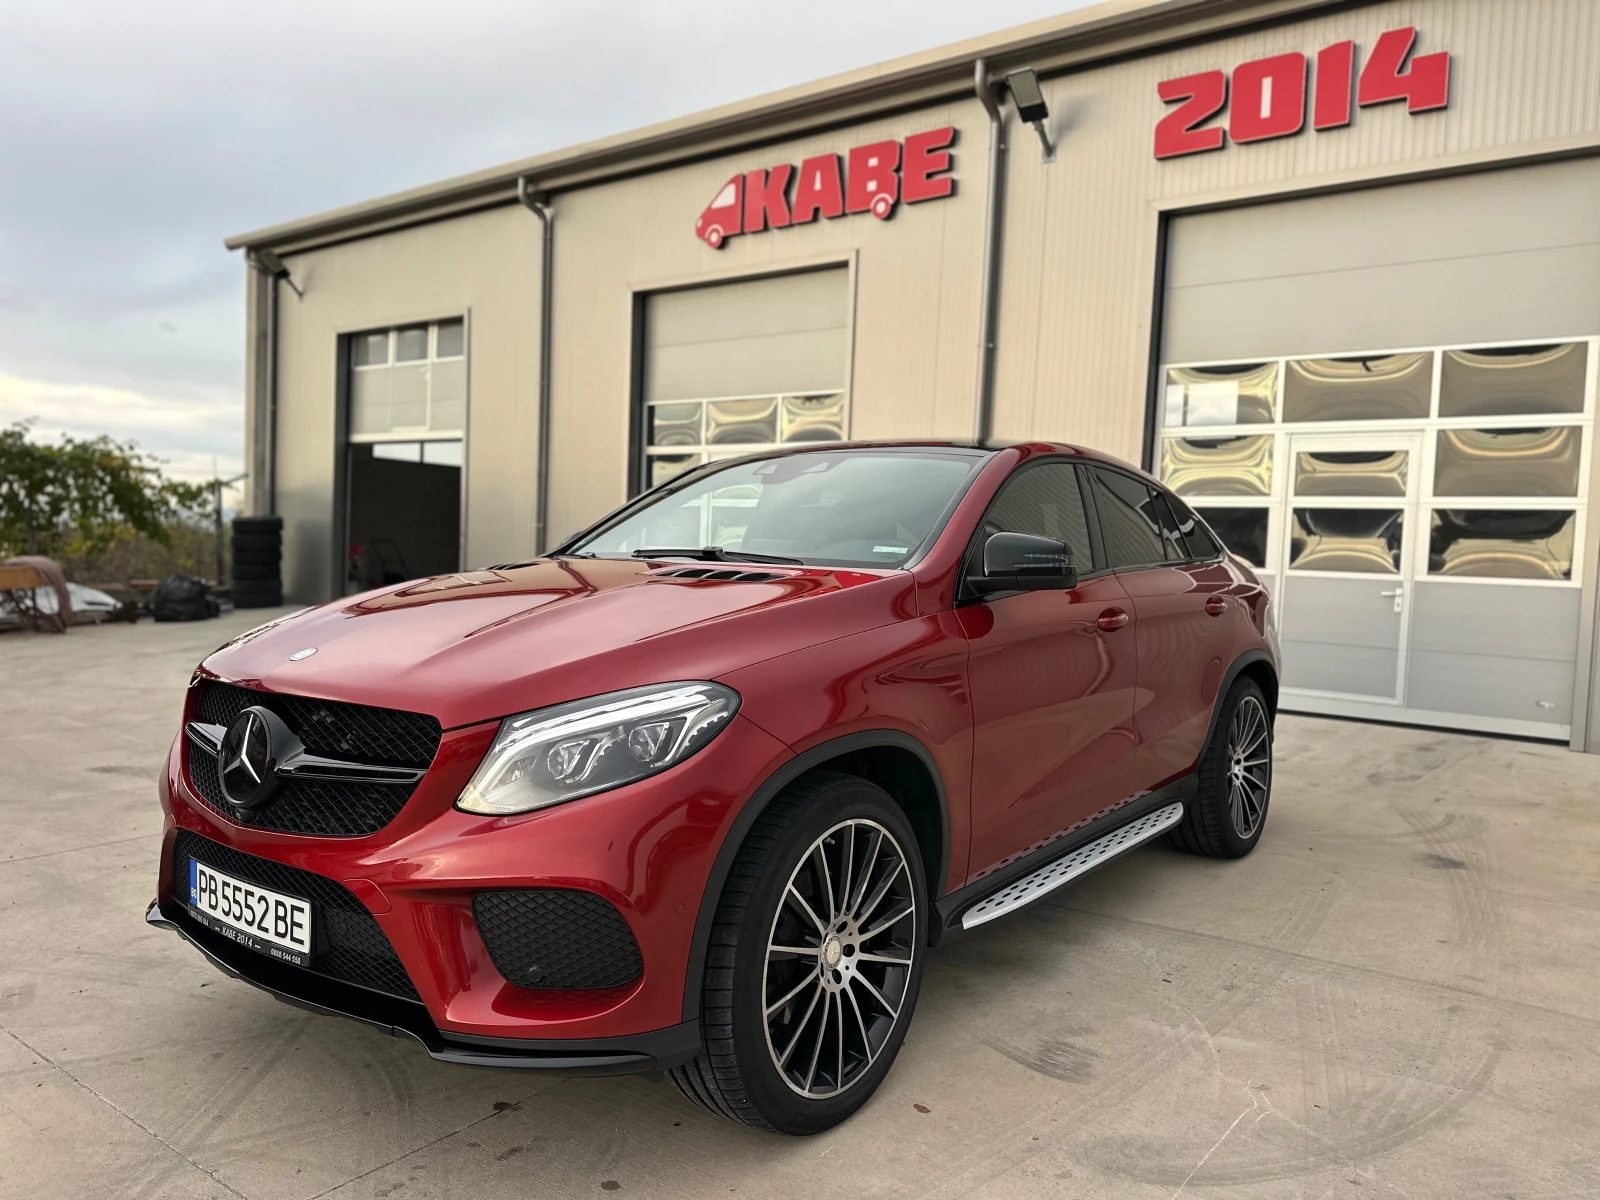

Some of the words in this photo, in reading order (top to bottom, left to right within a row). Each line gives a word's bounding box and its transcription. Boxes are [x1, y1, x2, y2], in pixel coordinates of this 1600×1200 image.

[743, 126, 955, 234] KABE
[1153, 26, 1450, 159] 2014
[199, 868, 219, 911] PB
[221, 880, 270, 934] 5552
[274, 899, 305, 946] BE
[222, 926, 237, 940] KABE
[236, 933, 253, 947] 2014
